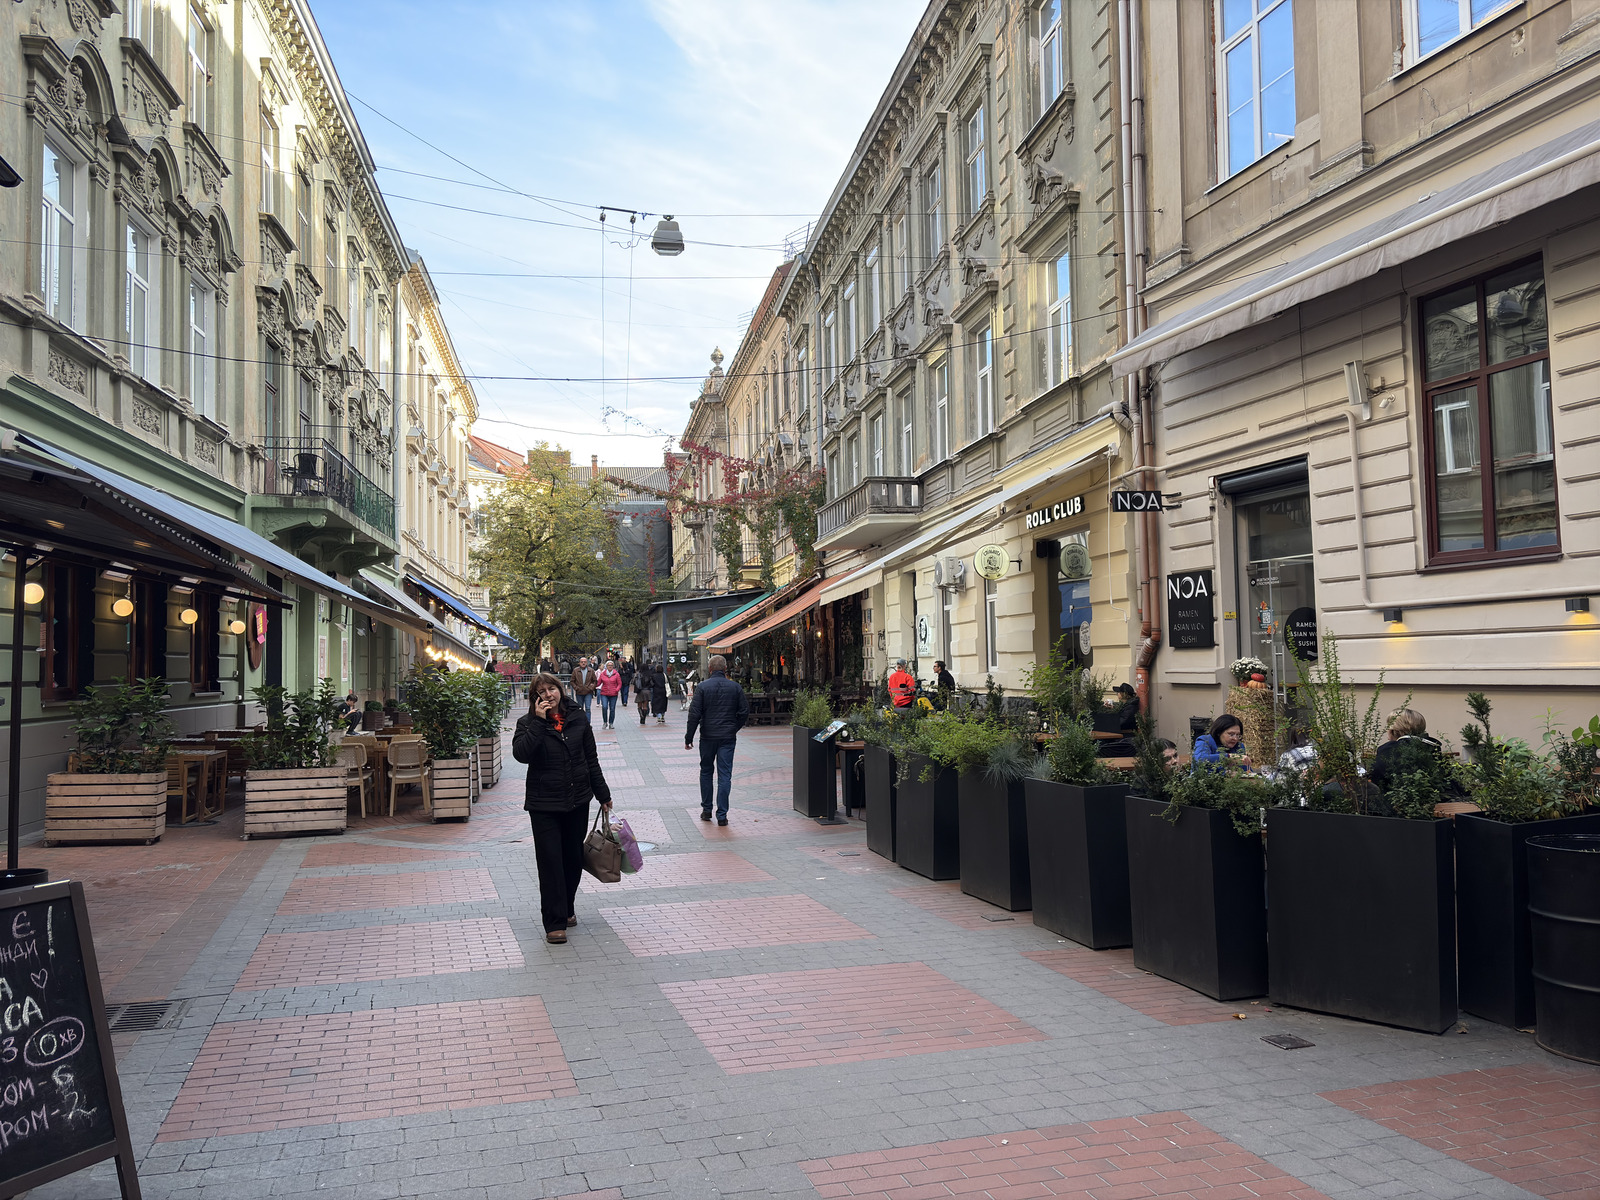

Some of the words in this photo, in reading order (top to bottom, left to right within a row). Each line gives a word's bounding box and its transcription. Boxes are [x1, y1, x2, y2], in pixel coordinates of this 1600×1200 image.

[1026, 510, 1051, 530] ROLL
[1053, 496, 1082, 520] CLUB
[1117, 492, 1160, 510] NOA
[1168, 574, 1208, 600] NOA
[1178, 610, 1199, 618] RAMEN
[1173, 623, 1190, 631] ASIAN
[1181, 635, 1198, 644] SUSHI
[0, 939, 38, 963] НДИ
[0, 995, 44, 1035] СА
[0, 1077, 35, 1108] ОМ
